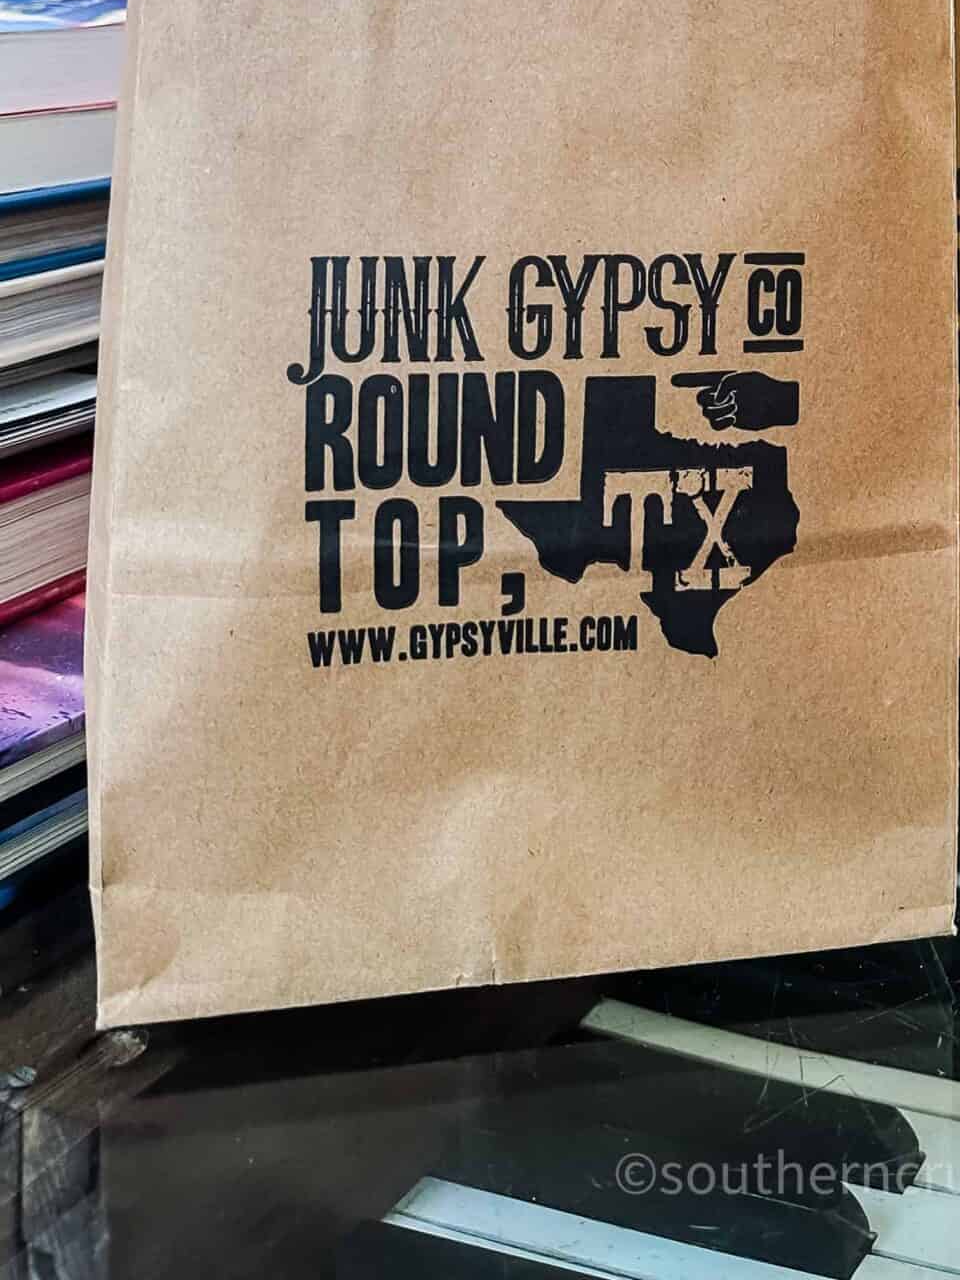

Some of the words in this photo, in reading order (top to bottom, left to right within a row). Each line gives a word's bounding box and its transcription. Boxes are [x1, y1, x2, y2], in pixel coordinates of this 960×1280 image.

[287, 255, 486, 385] JUNK
[506, 253, 737, 361] GYPSY
[747, 268, 803, 337] CO
[304, 369, 566, 493] ROUND
[304, 496, 526, 617] TOP,
[601, 465, 754, 593] TX
[307, 614, 638, 668] WWW.GYPSYVILLE.COM
